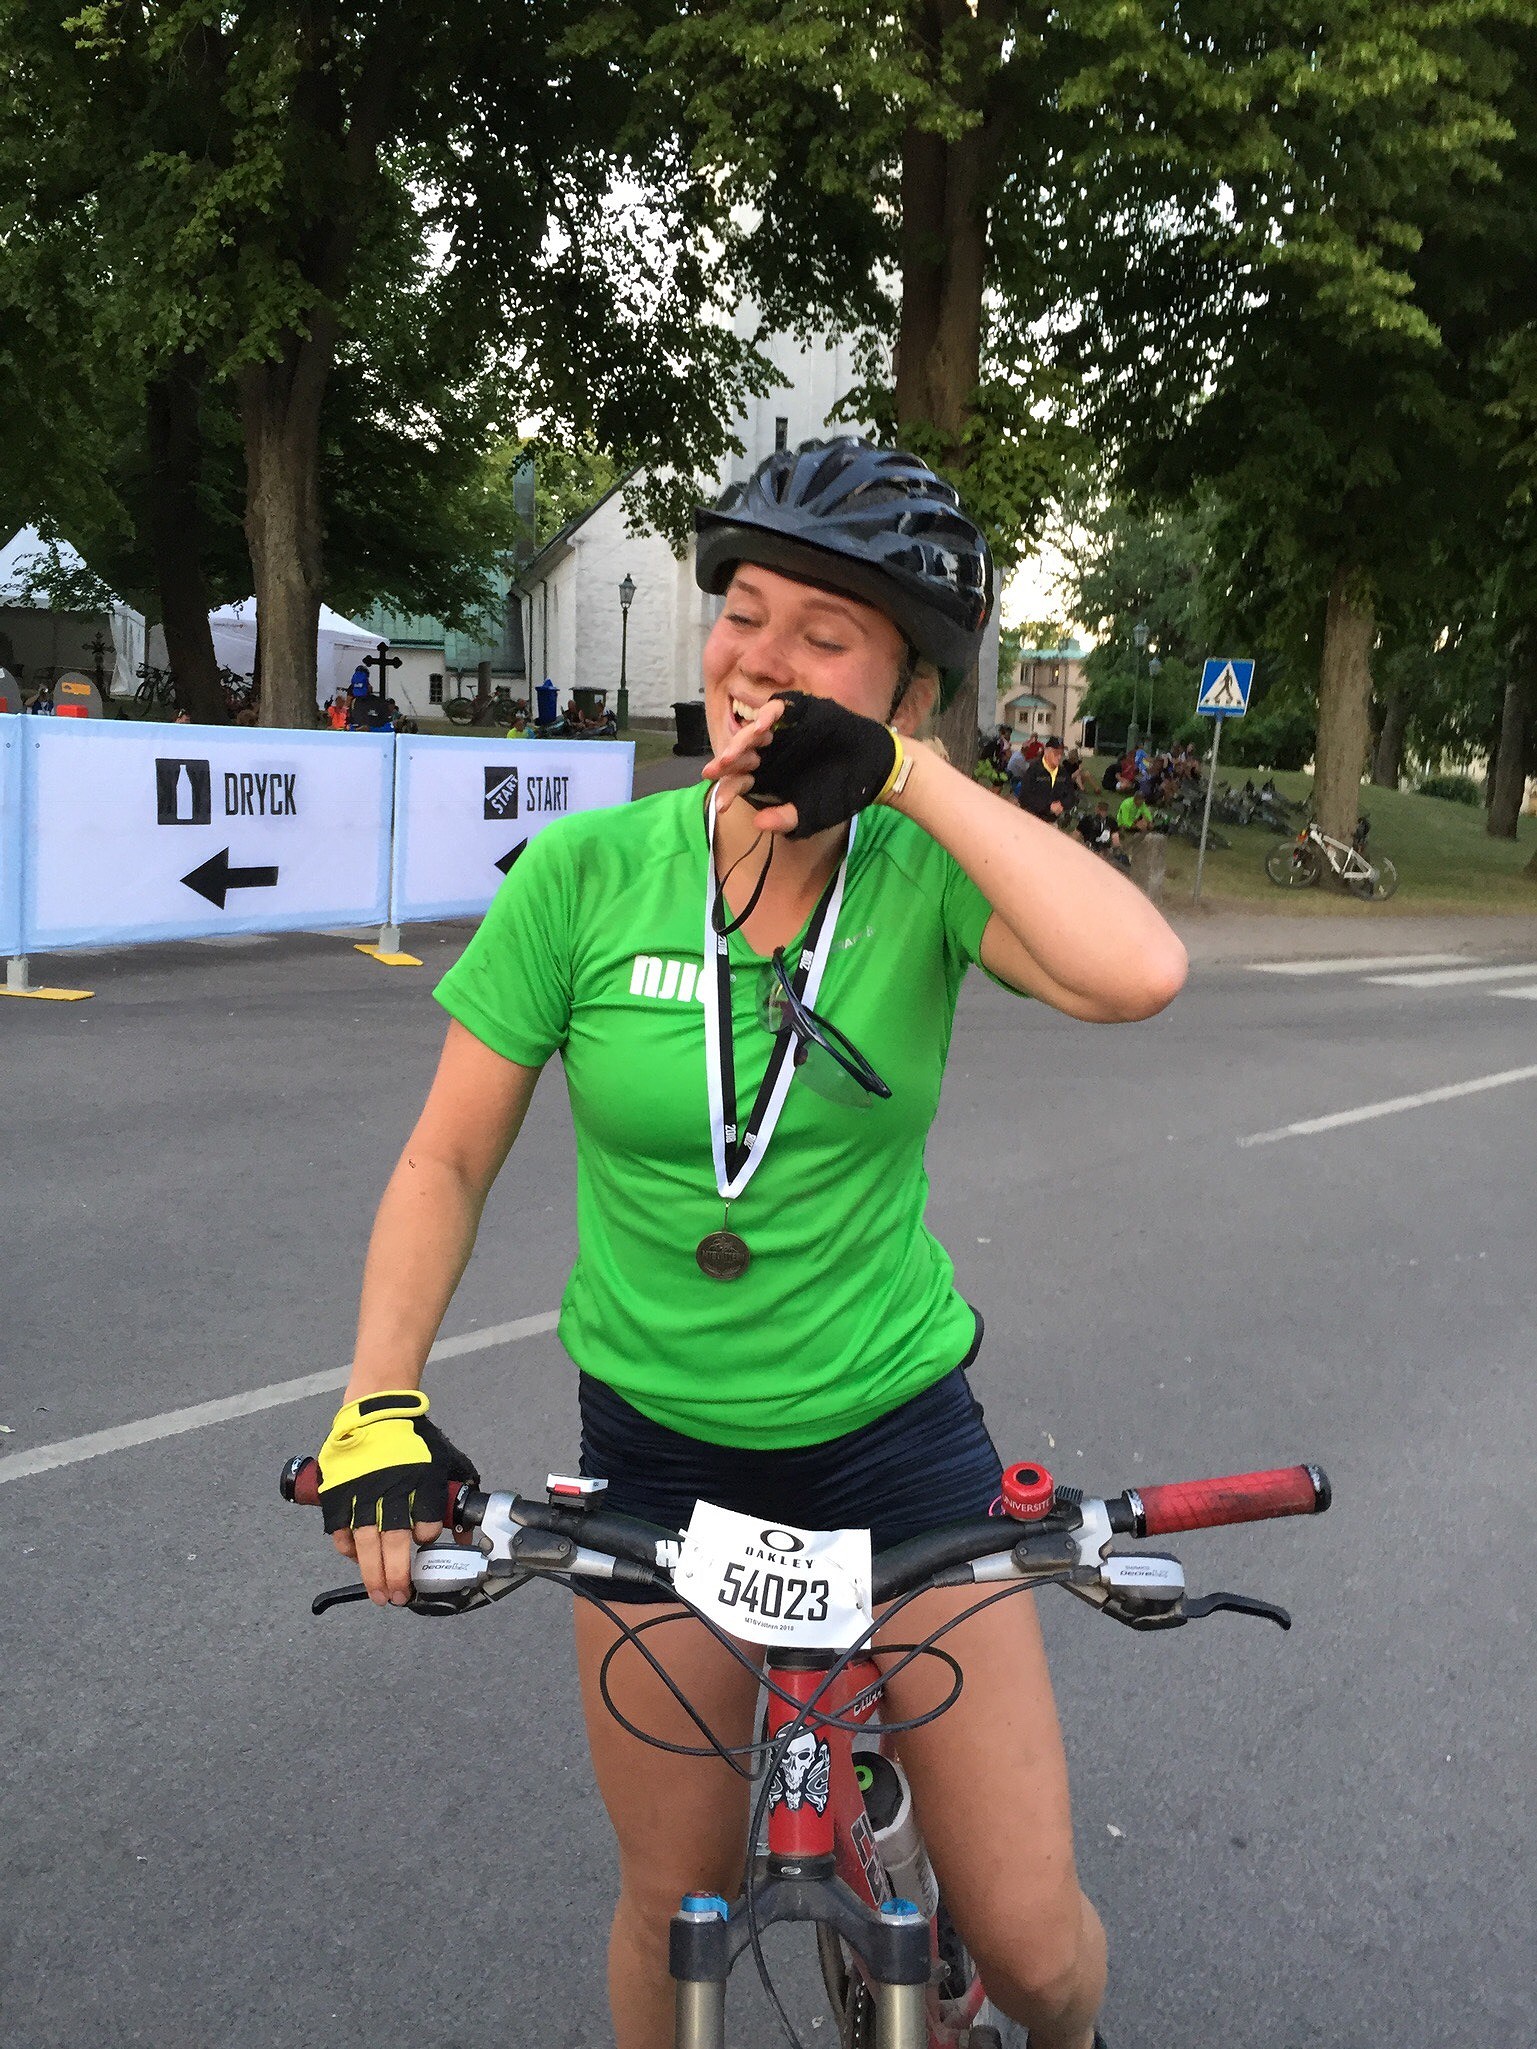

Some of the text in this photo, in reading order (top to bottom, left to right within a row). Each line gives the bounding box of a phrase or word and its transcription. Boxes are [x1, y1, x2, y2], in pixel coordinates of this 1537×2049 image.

[224, 772, 297, 816] DRYCK
[491, 775, 519, 815] START
[526, 776, 569, 811] START
[745, 1546, 815, 1568] OAKLEY
[718, 1562, 829, 1621] 54023
